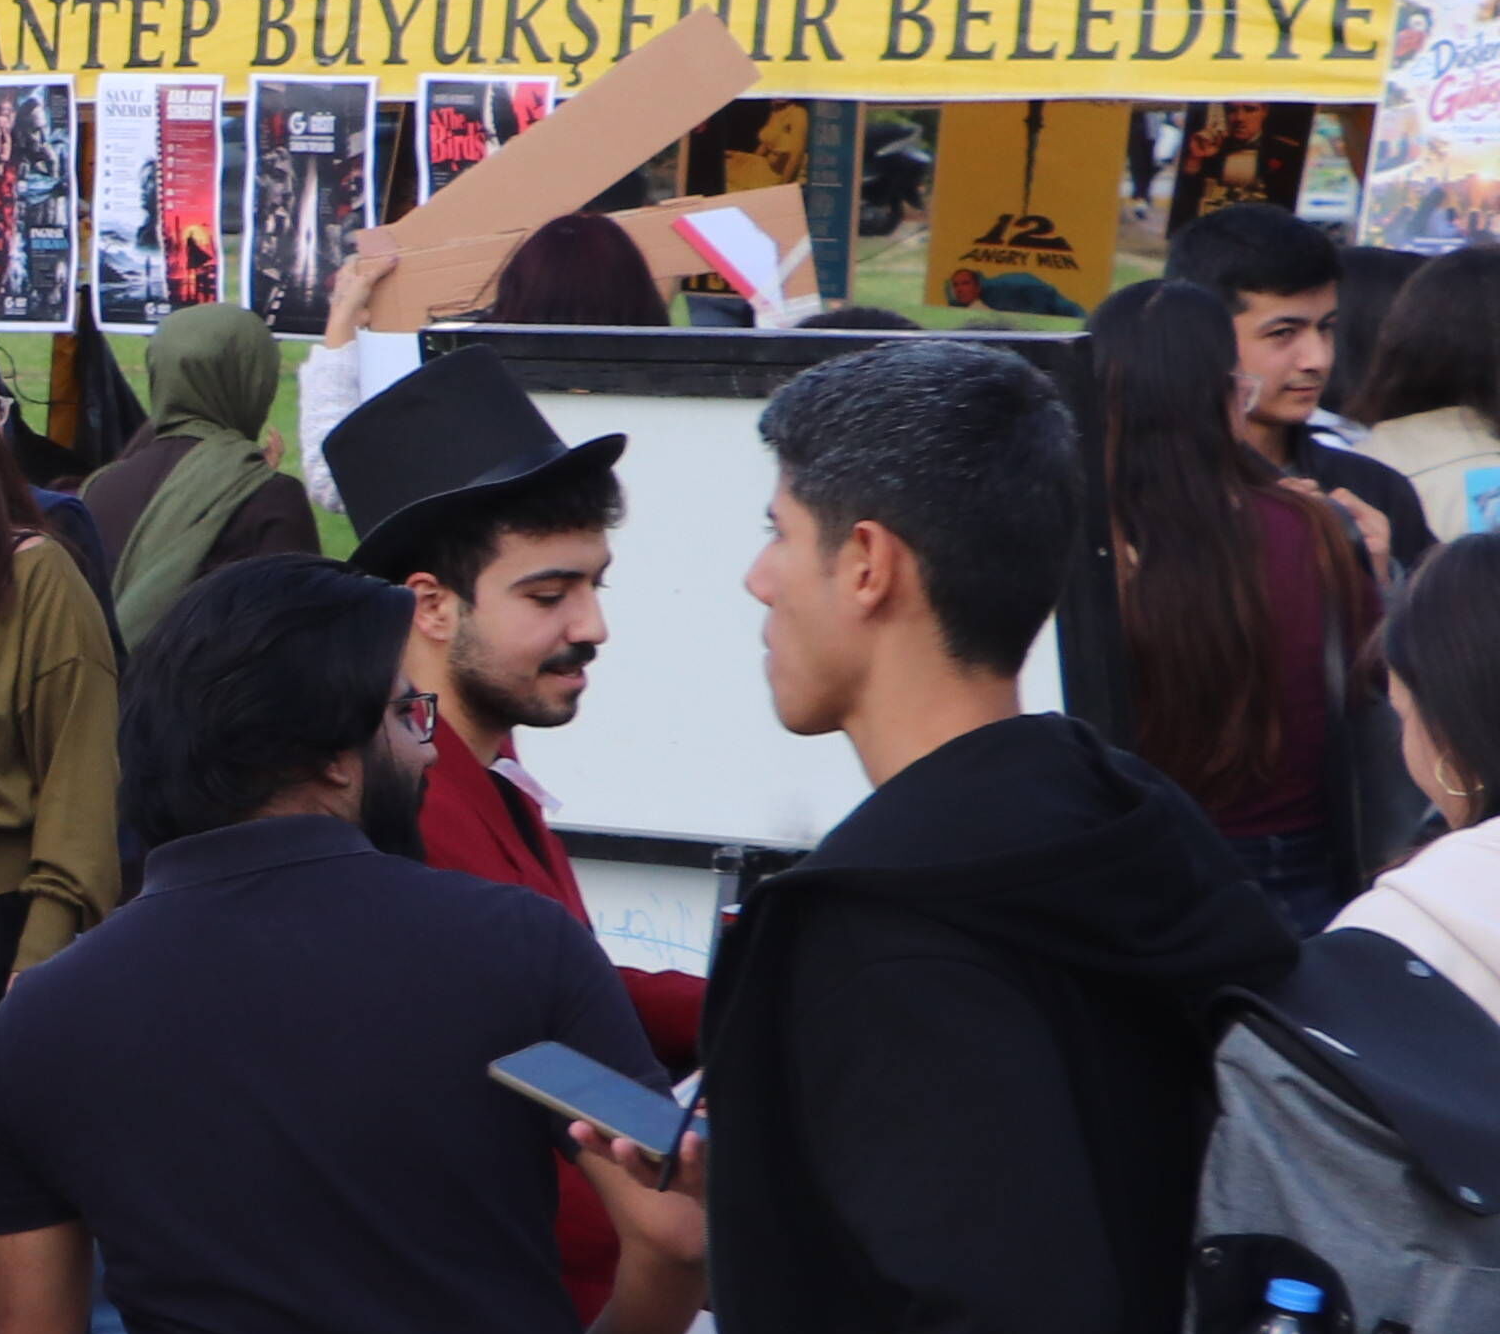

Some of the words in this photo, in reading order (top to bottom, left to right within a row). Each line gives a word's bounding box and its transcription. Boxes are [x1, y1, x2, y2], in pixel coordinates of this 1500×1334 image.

[430, 121, 486, 163] Birds
[974, 213, 1074, 252] 12
[958, 249, 1029, 267] ANGRY
[1037, 253, 1080, 269] MEN
